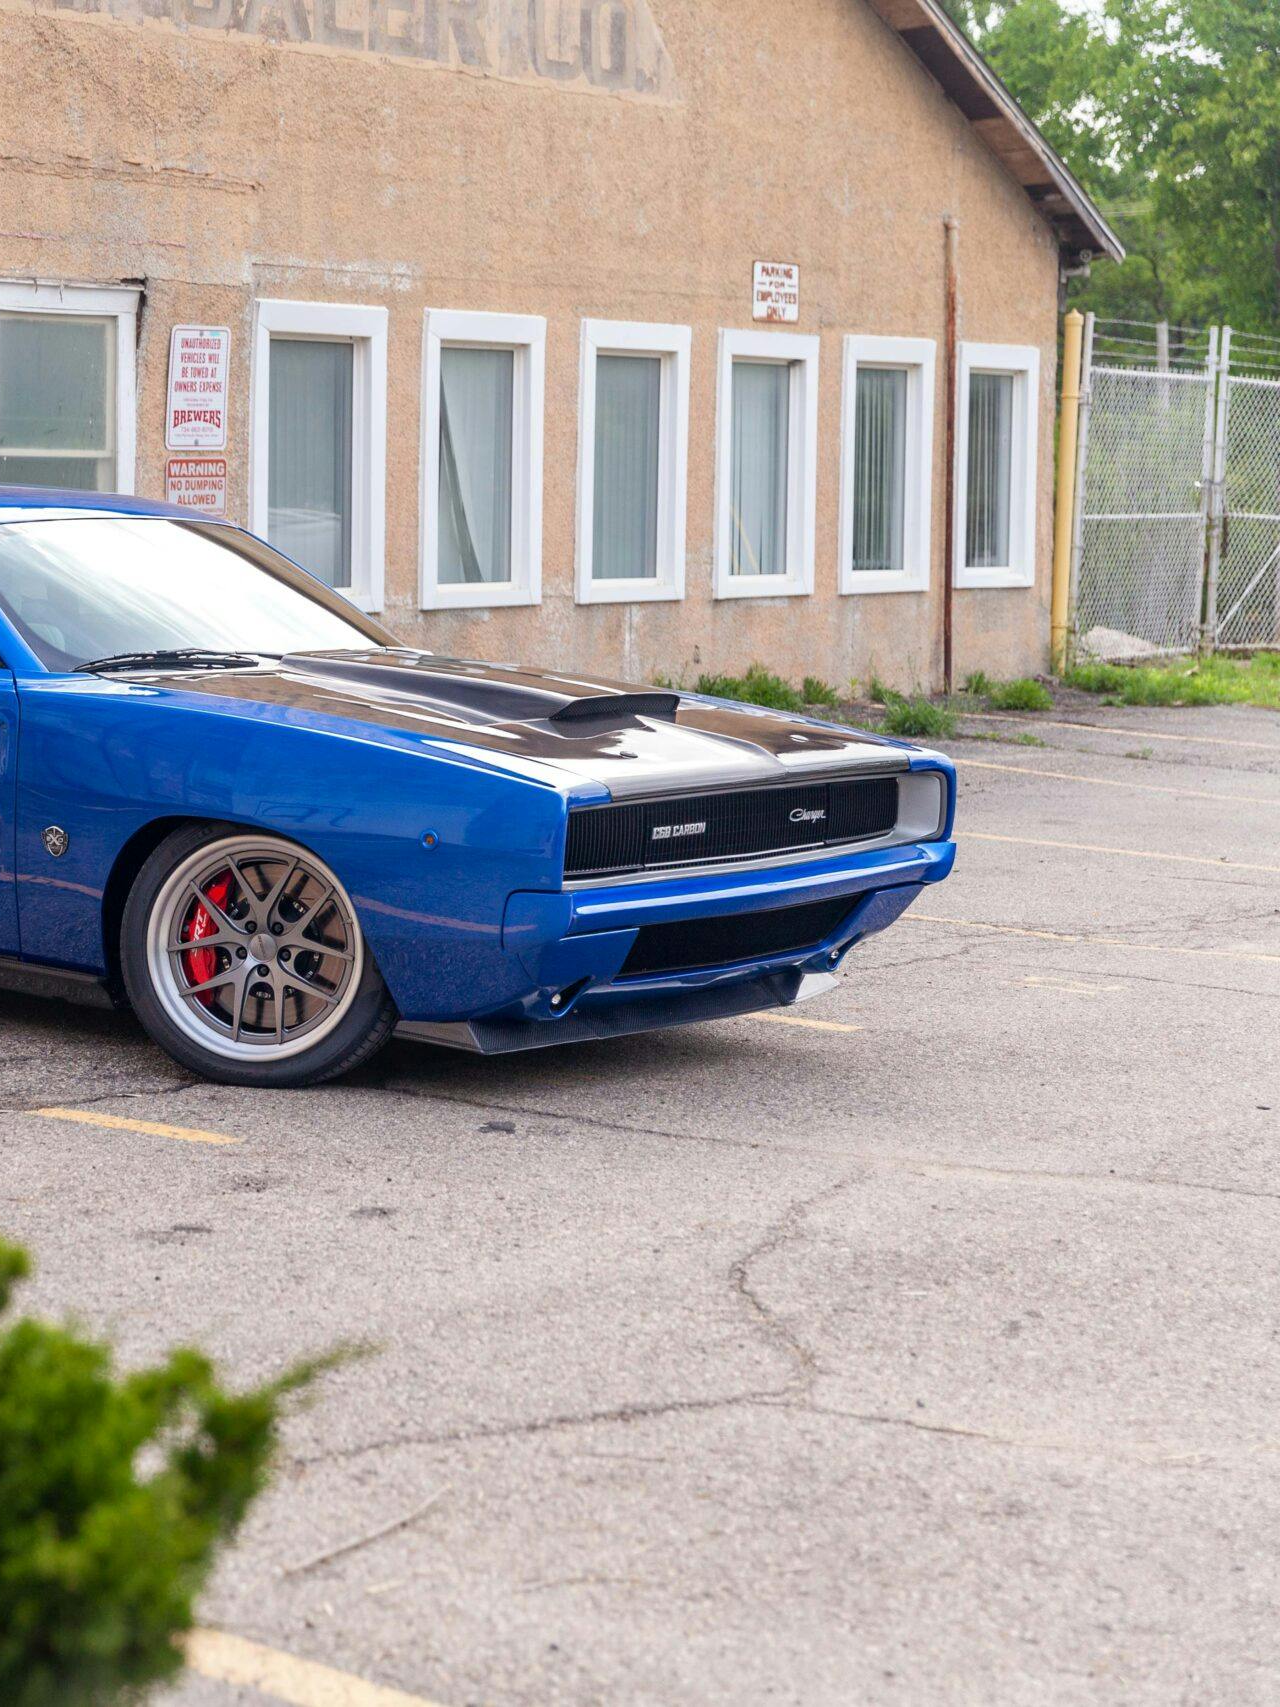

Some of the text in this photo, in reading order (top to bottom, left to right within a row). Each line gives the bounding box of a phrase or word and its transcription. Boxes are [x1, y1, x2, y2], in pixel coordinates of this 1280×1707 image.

[181, 338, 221, 350] UNAUTHORIZED
[180, 352, 220, 364] VEHICLES WILL
[181, 366, 218, 378] BE TOWED AT
[174, 380, 222, 393] OWNERS EXPENSE
[172, 409, 221, 429] BREWERS
[169, 462, 225, 476] WARNING
[170, 480, 224, 491] NO DUMPING
[176, 494, 217, 505] ALLOWED
[672, 821, 706, 837] CARBON
